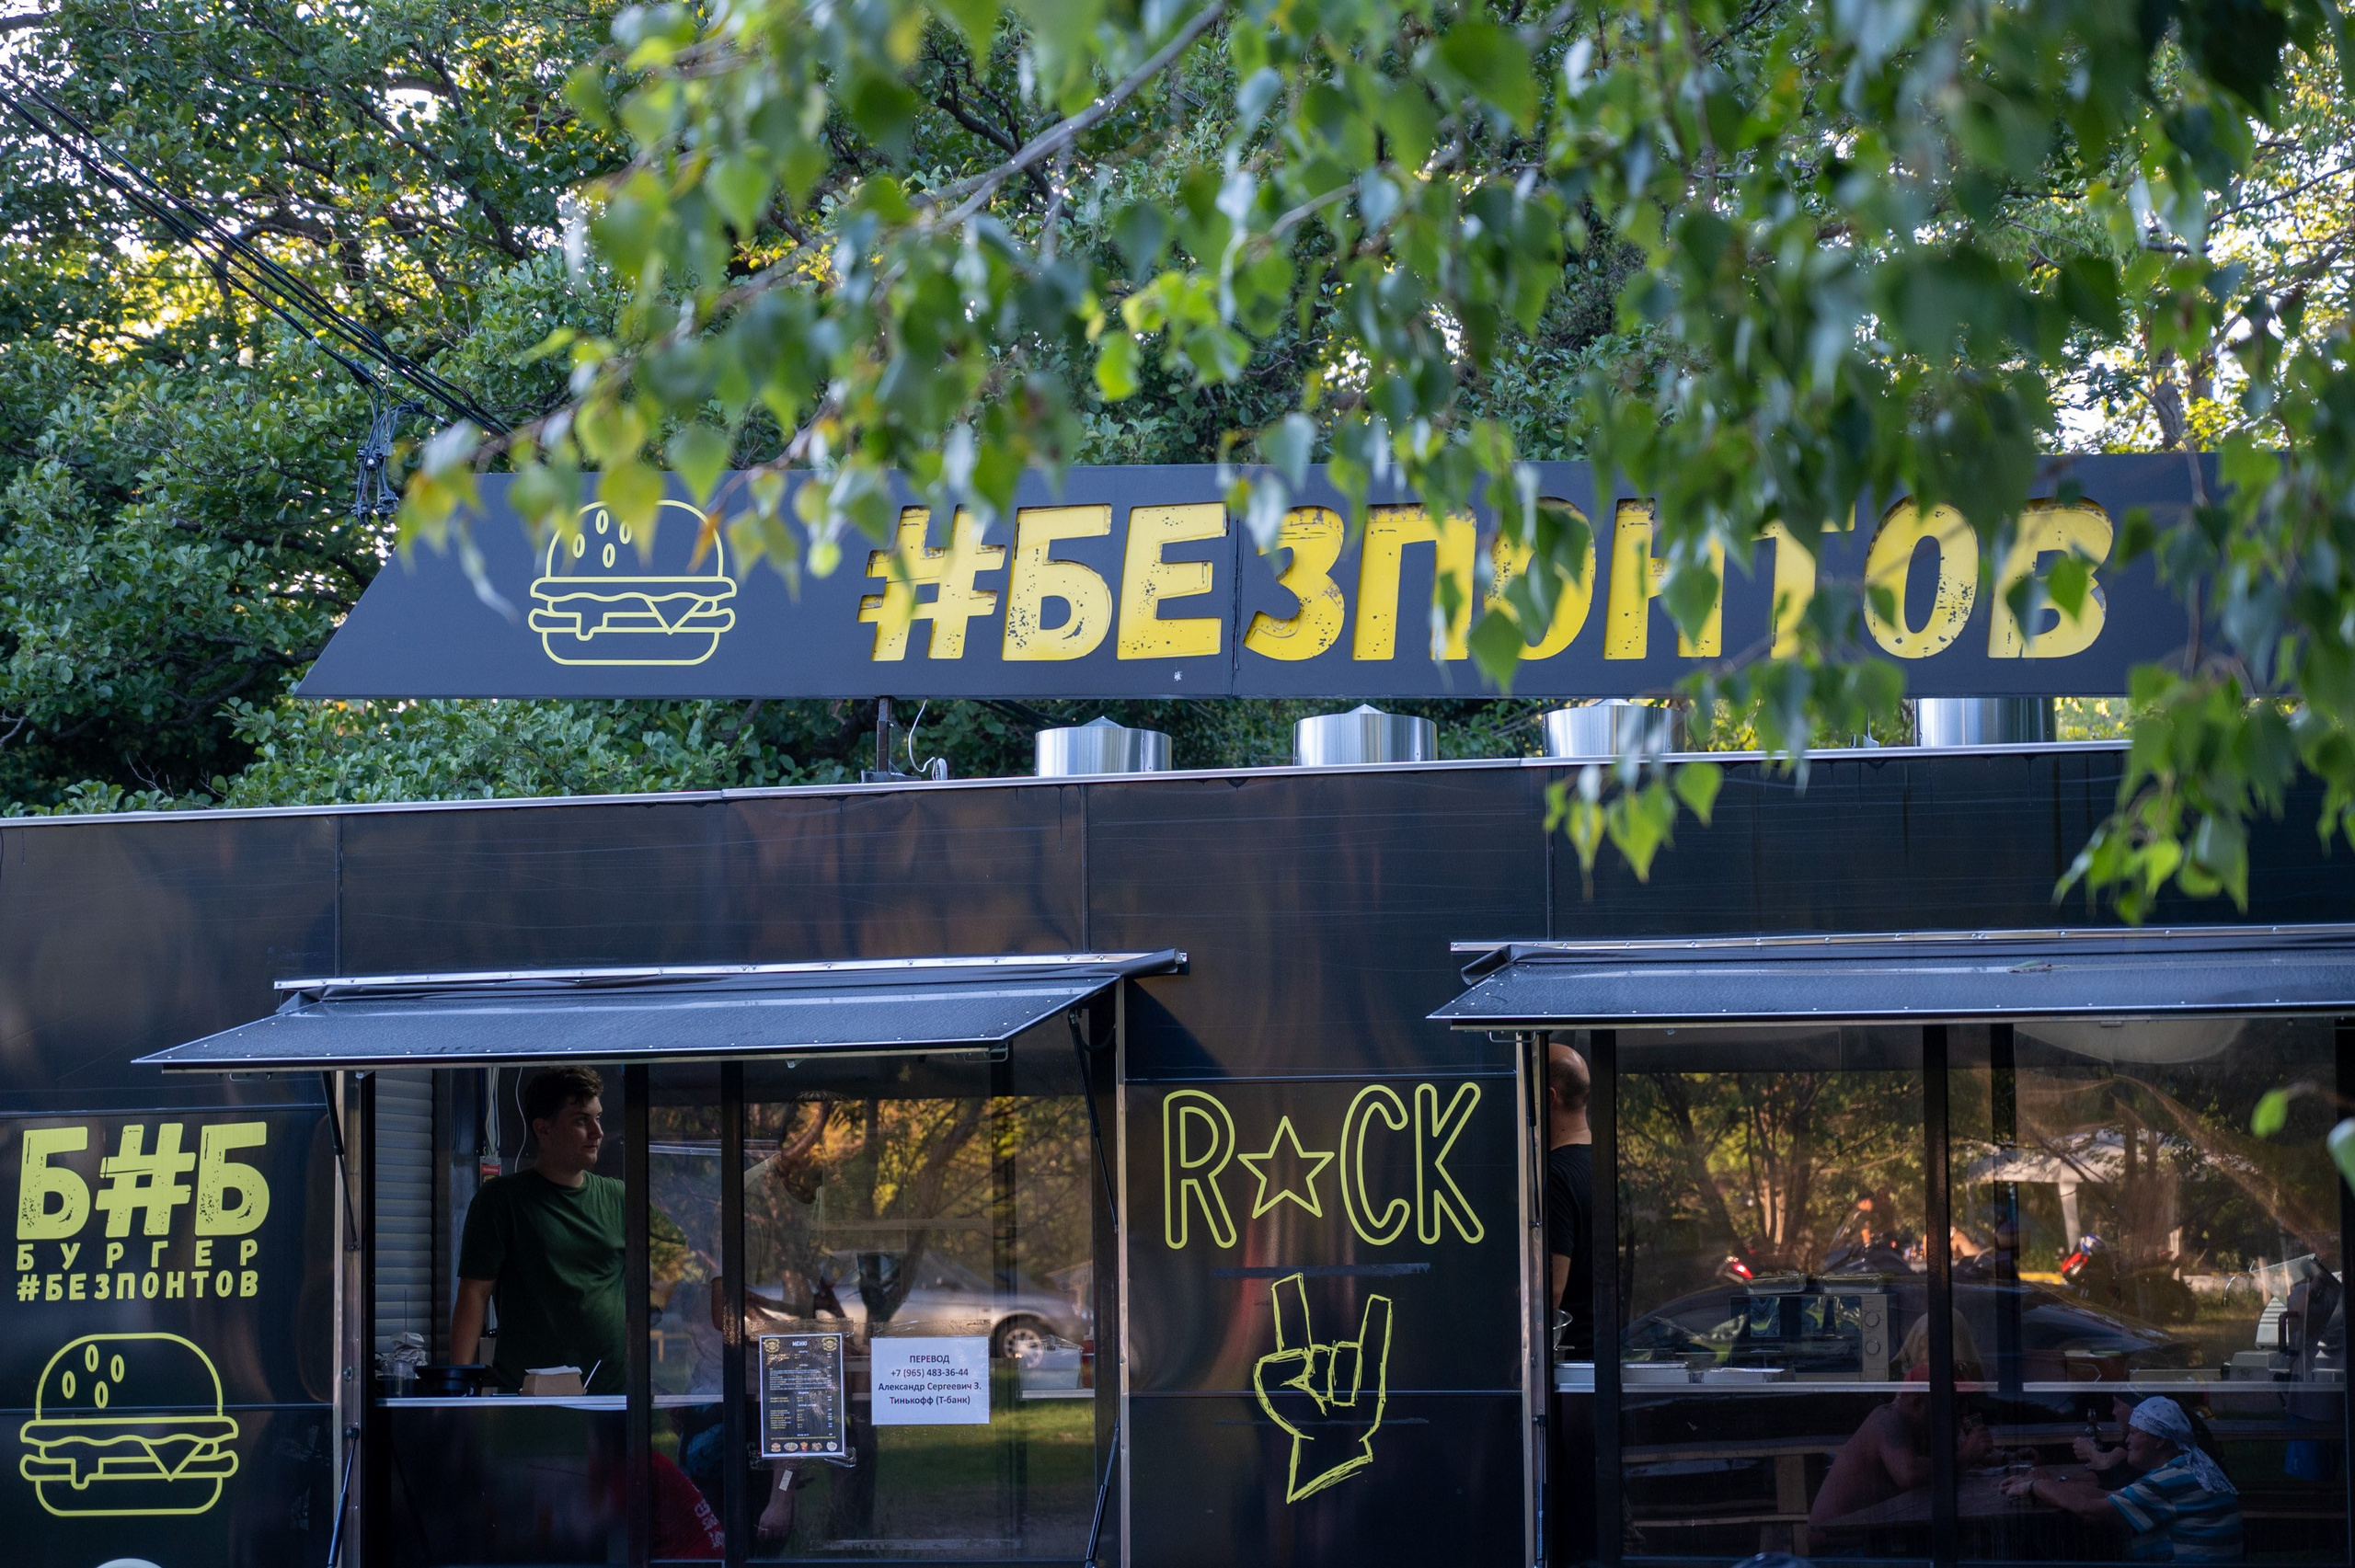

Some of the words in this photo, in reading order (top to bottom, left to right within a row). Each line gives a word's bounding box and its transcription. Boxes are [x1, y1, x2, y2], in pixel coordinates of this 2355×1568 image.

[17, 1122, 270, 1240] Б#Б
[17, 1240, 258, 1271] БУРГЕР
[17, 1270, 258, 1301] #БЕЗПОНТОВ
[909, 1355, 950, 1364] ПЕРЕВОД
[903, 1368, 925, 1379] (965)
[926, 1368, 969, 1377] 483-36-44
[878, 1382, 925, 1391] Александр
[926, 1382, 972, 1391] Сергеевич
[889, 1396, 934, 1405] Тинькофф
[936, 1395, 971, 1405] (Т-банк)
